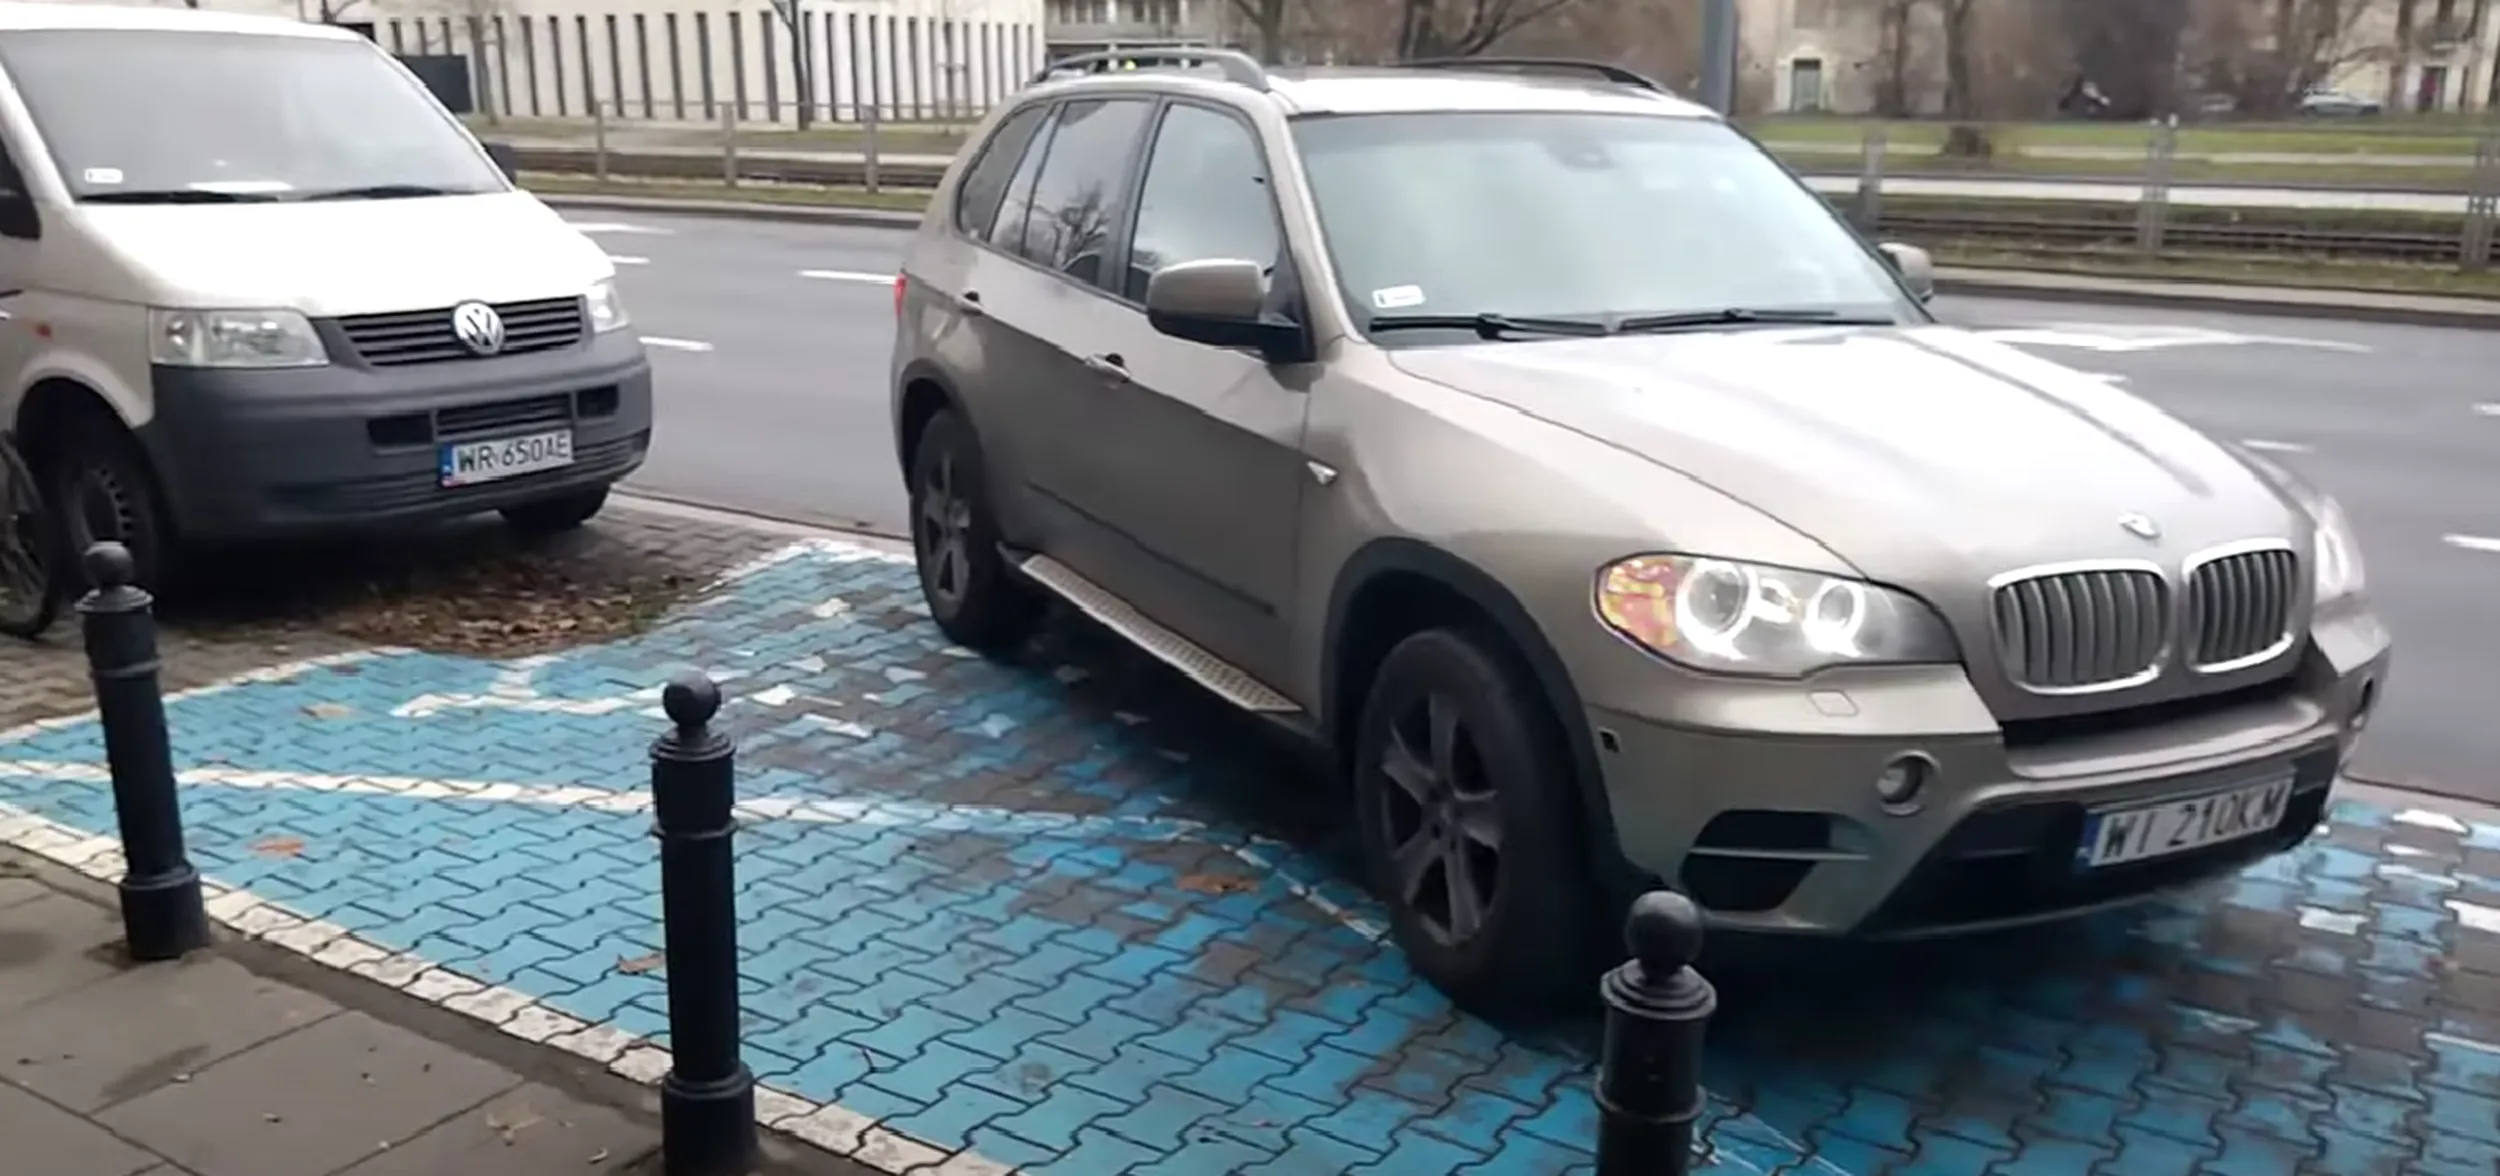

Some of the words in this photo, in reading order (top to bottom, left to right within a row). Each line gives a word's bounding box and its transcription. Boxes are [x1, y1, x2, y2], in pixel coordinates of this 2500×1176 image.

[457, 444, 493, 473] WR
[501, 433, 569, 467] 650AE
[2102, 811, 2158, 859] WI
[2166, 785, 2288, 848] 210KM
